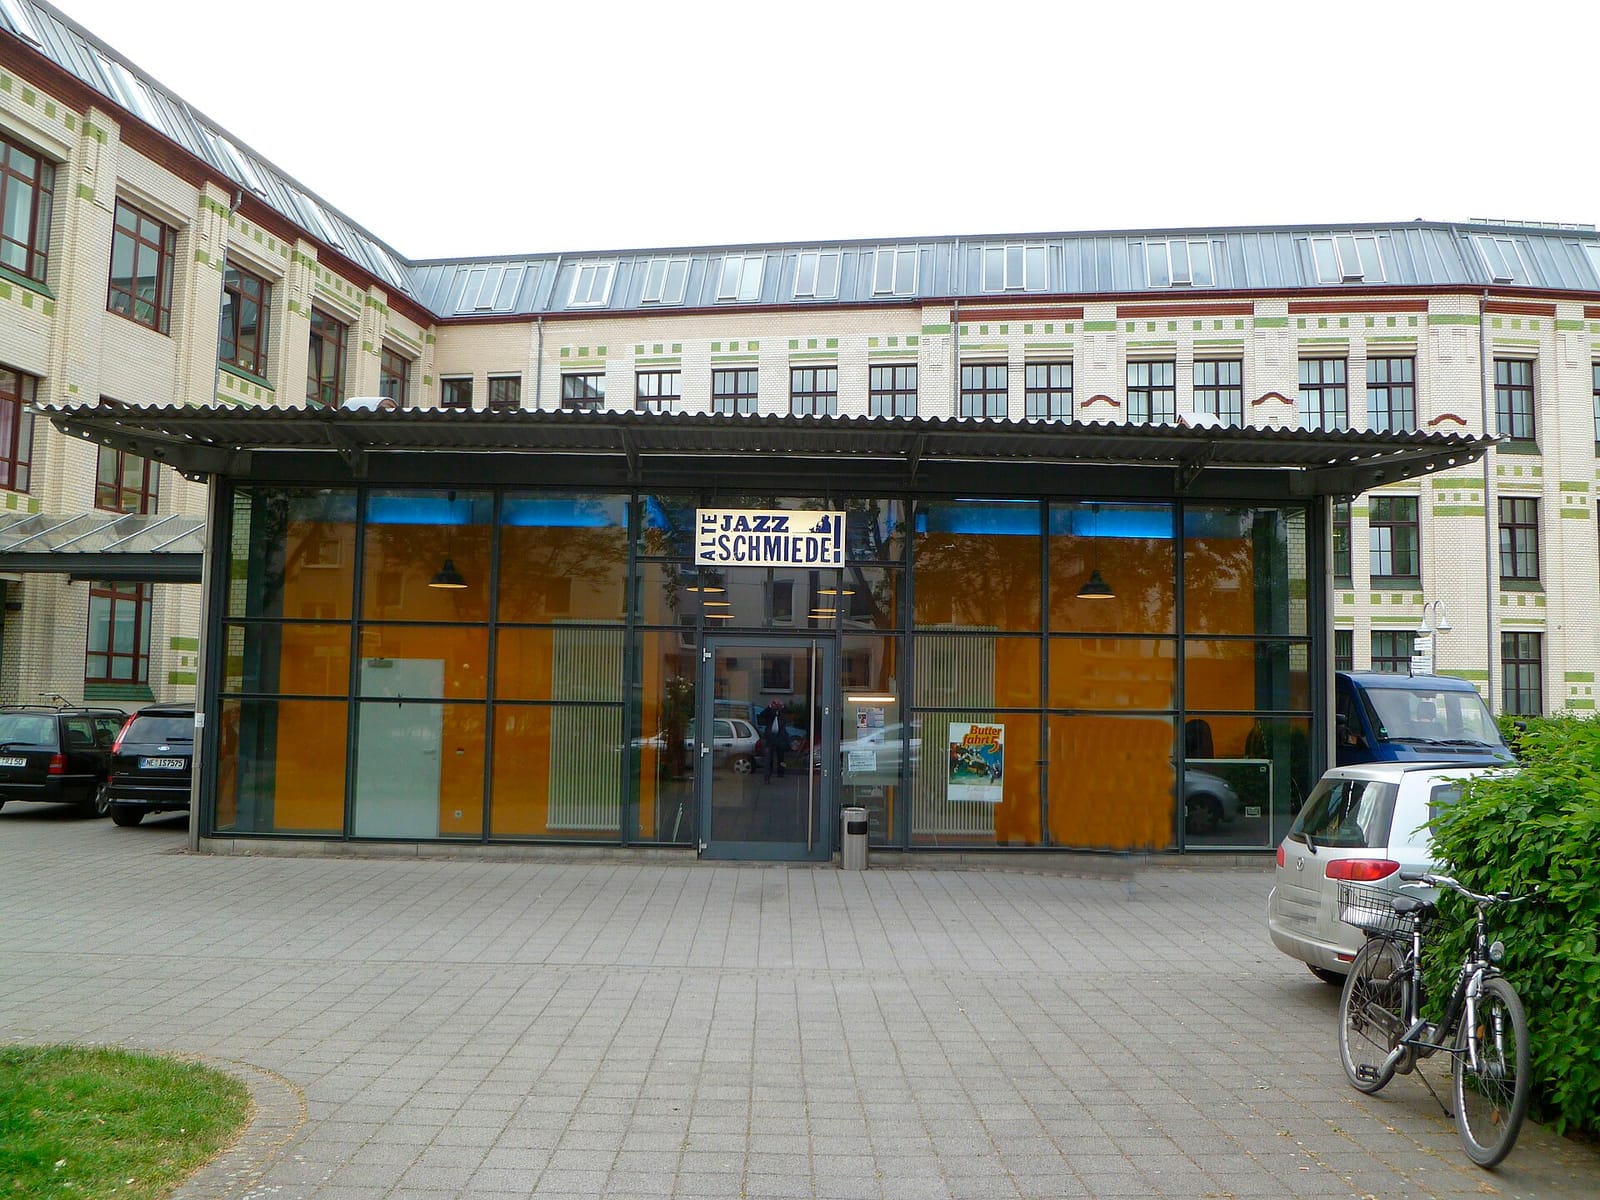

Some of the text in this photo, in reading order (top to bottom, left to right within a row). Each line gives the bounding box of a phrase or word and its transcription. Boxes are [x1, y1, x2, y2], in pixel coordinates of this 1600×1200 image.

[720, 515, 789, 533] JAZZ
[700, 514, 717, 561] ALTE
[970, 725, 1002, 736] Butter
[962, 734, 1000, 754] fahrt 5
